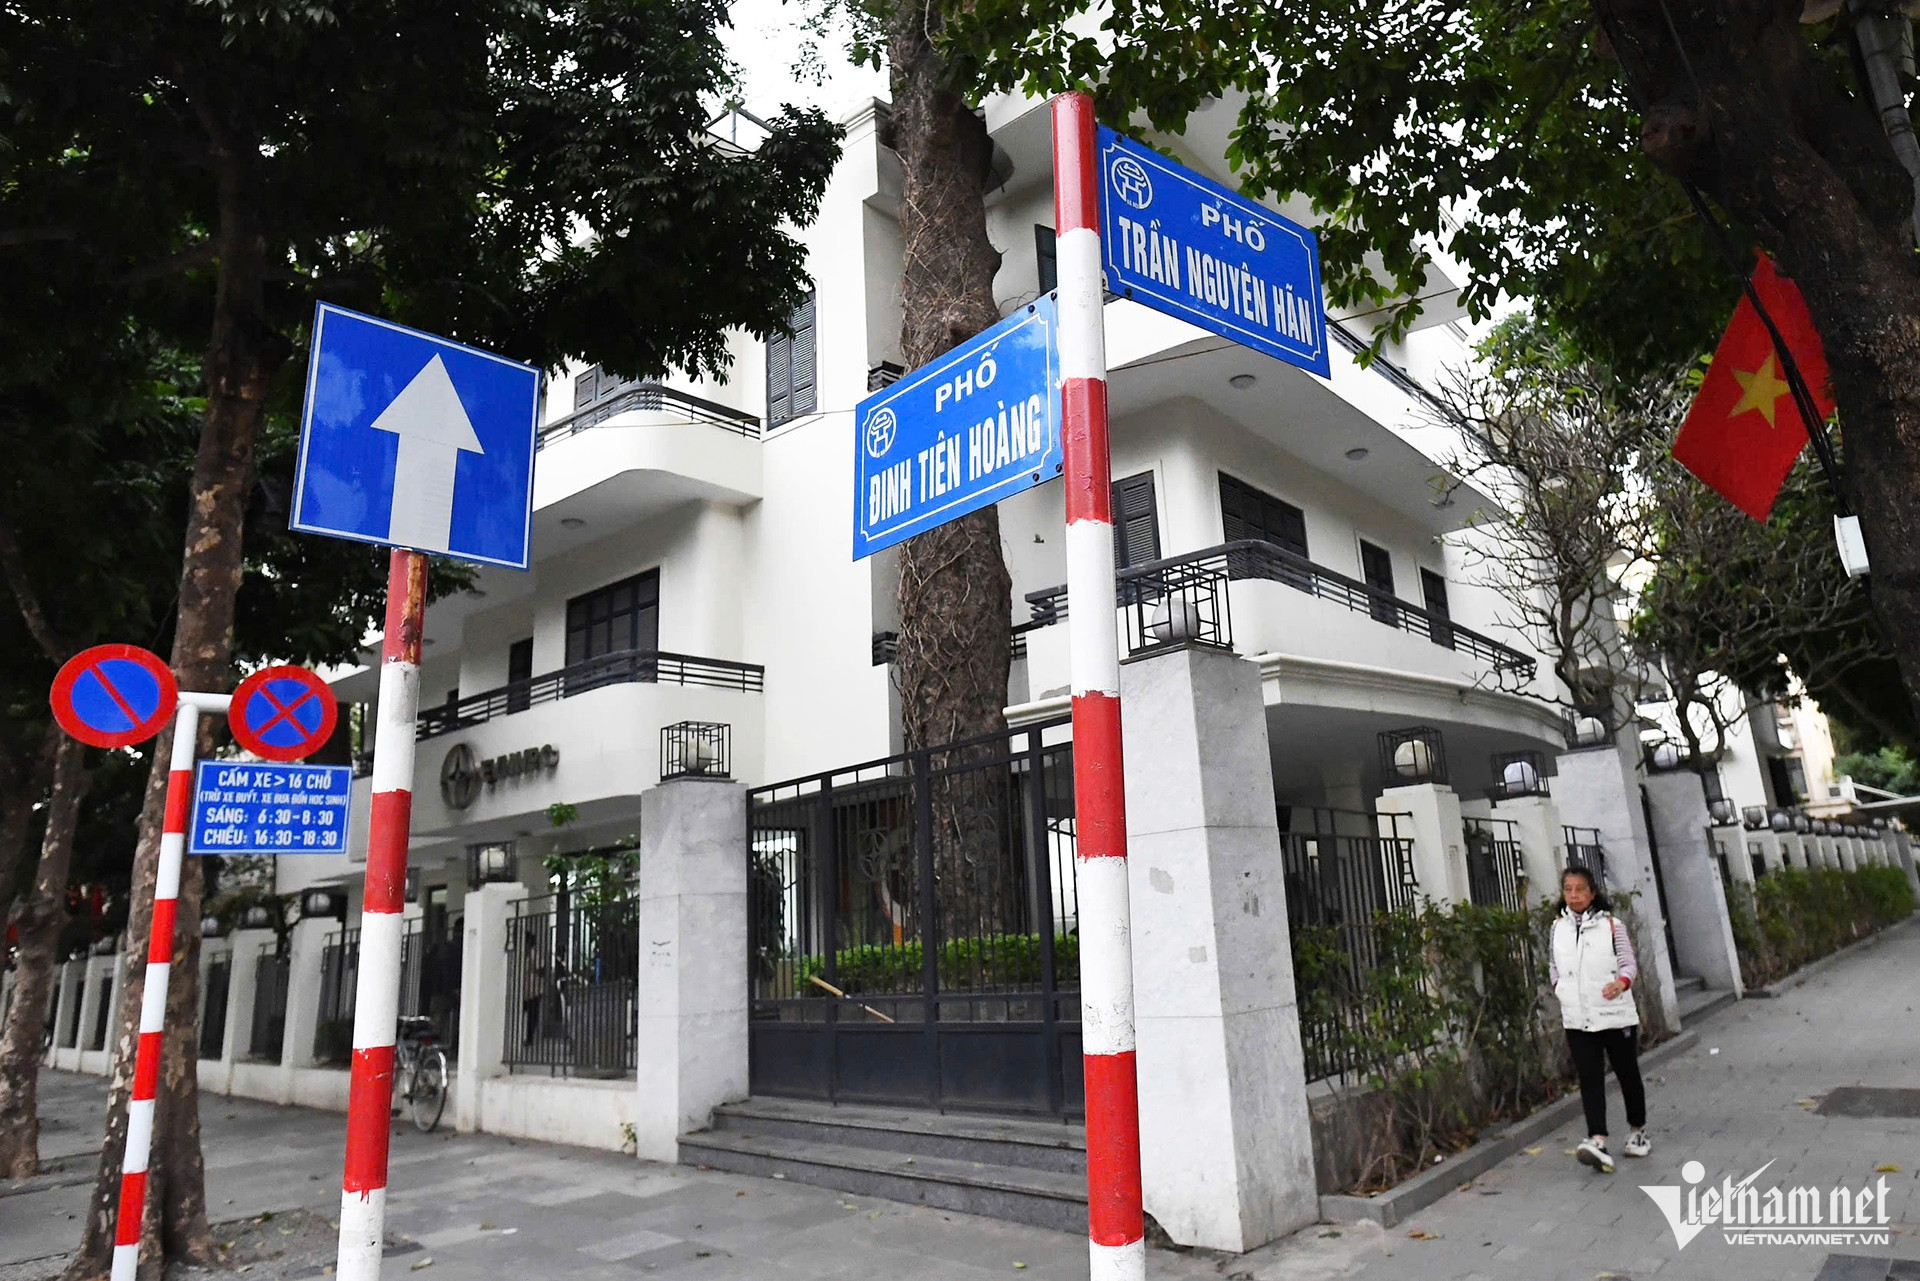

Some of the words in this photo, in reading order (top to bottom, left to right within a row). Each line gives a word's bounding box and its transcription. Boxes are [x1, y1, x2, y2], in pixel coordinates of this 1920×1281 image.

[1201, 203, 1266, 252] PHỐ
[1118, 216, 1181, 290] TRẦN
[1186, 246, 1269, 327] NGUYÊN
[1272, 283, 1313, 346] HÃN
[935, 342, 1000, 413] PHỐ
[869, 458, 911, 526] ĐINH
[918, 430, 961, 503] TIÊN
[968, 393, 1041, 482] HOÀNG
[218, 766, 249, 787] CẤM
